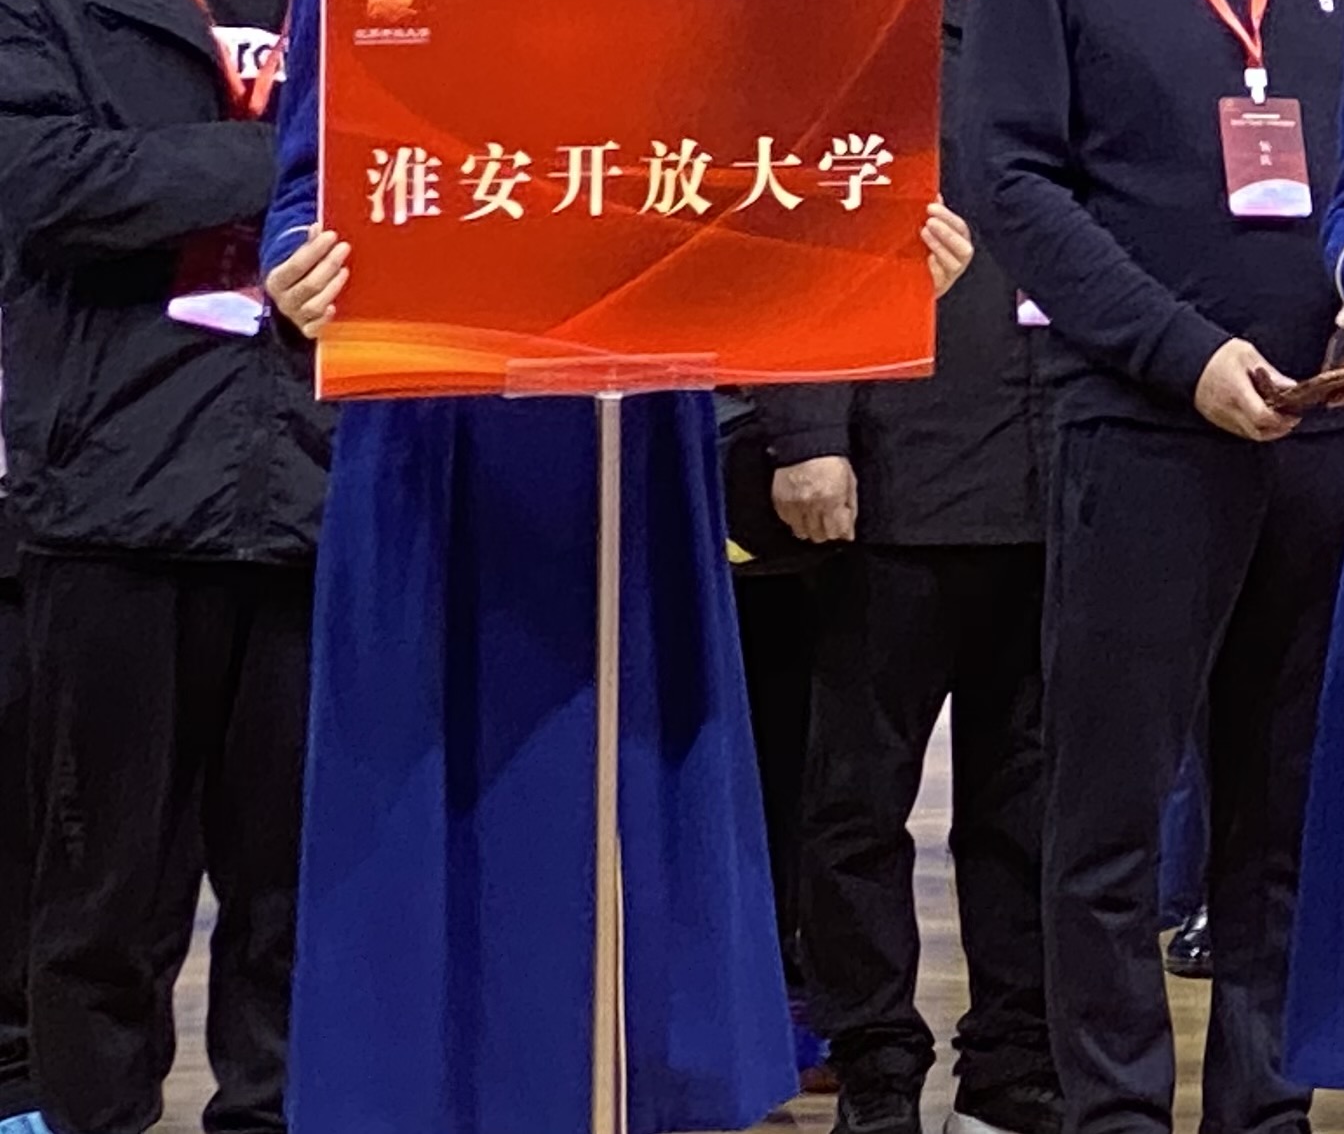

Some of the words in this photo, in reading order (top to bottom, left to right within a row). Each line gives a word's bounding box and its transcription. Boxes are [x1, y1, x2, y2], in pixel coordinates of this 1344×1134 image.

[365, 132, 895, 226] 淮安开放大学
